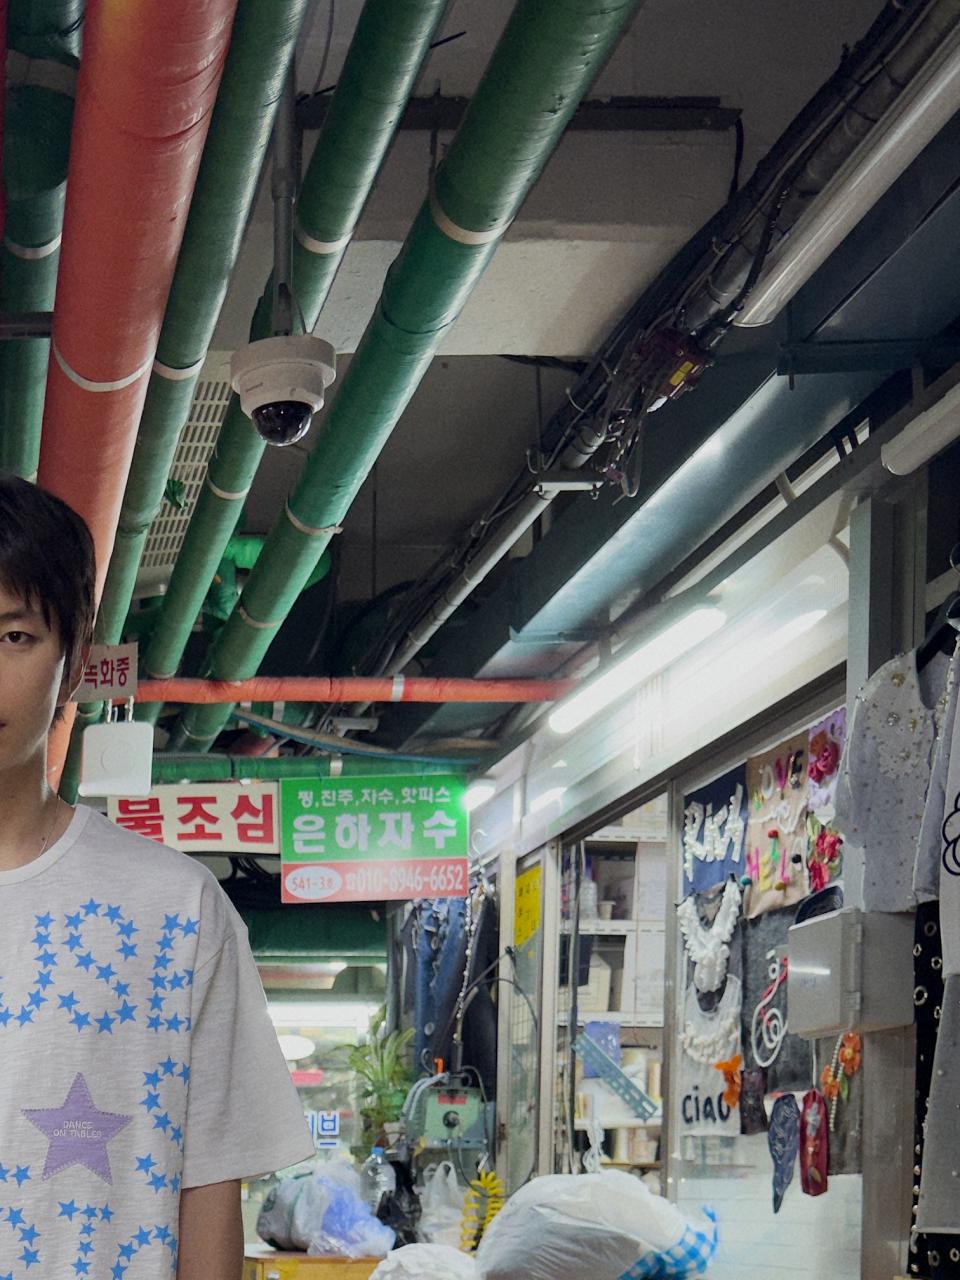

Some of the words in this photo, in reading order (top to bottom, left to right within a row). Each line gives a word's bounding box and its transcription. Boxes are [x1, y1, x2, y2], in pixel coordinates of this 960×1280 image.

[84, 657, 130, 689] 녹화중
[115, 793, 274, 844] 불조심
[292, 810, 457, 854] 은하자수
[53, 1128, 66, 1138] ON
[63, 1120, 94, 1130] DANCE
